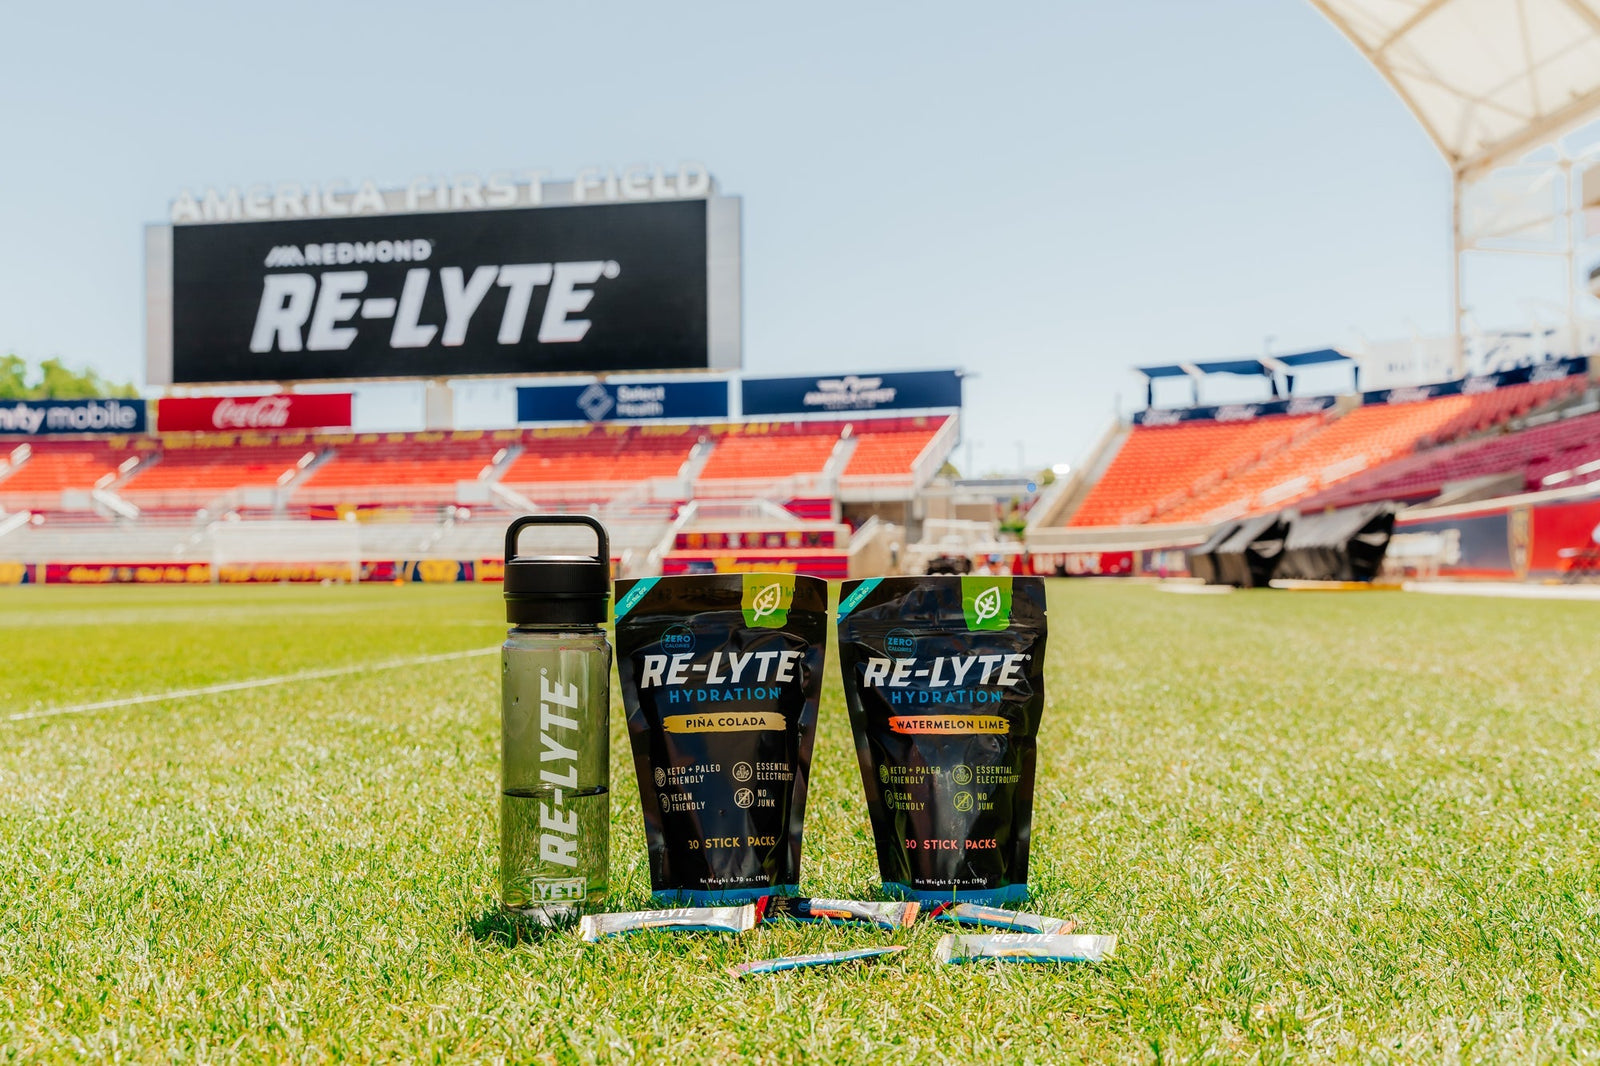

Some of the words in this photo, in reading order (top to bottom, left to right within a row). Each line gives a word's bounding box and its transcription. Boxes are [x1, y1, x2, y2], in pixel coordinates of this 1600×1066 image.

[171, 179, 388, 224] AMERICA
[406, 168, 549, 210] FIRST
[574, 161, 712, 202] FIELD
[305, 238, 432, 264] REDMOND
[46, 401, 138, 430] mobile
[665, 634, 691, 643] ZERO
[888, 637, 913, 647] ZERO
[686, 716, 714, 728] PIÑA
[719, 717, 766, 727] COLADA
[896, 721, 975, 729] WATERMELON
[978, 720, 1004, 729] LIME
[667, 766, 686, 776] KETO
[695, 764, 721, 774] PALEO
[915, 766, 941, 775] PALEO
[976, 765, 1012, 774] ESSENTIAL
[668, 774, 704, 785] FRIENDLY
[671, 792, 693, 802] VEGAN
[757, 789, 767, 797] NO
[977, 792, 988, 801] NO
[672, 801, 706, 811] FRIENDLY
[757, 799, 776, 808] JUNK
[977, 802, 994, 811] JUNK
[688, 840, 699, 850] 30
[705, 837, 740, 849] STICK
[747, 836, 776, 847] PACKS
[905, 839, 917, 849] 30
[923, 839, 958, 849] STICK
[965, 838, 997, 849] PACKS
[926, 878, 946, 887] Weight
[537, 883, 582, 899] YETI
[631, 907, 695, 920] RE-LYTE
